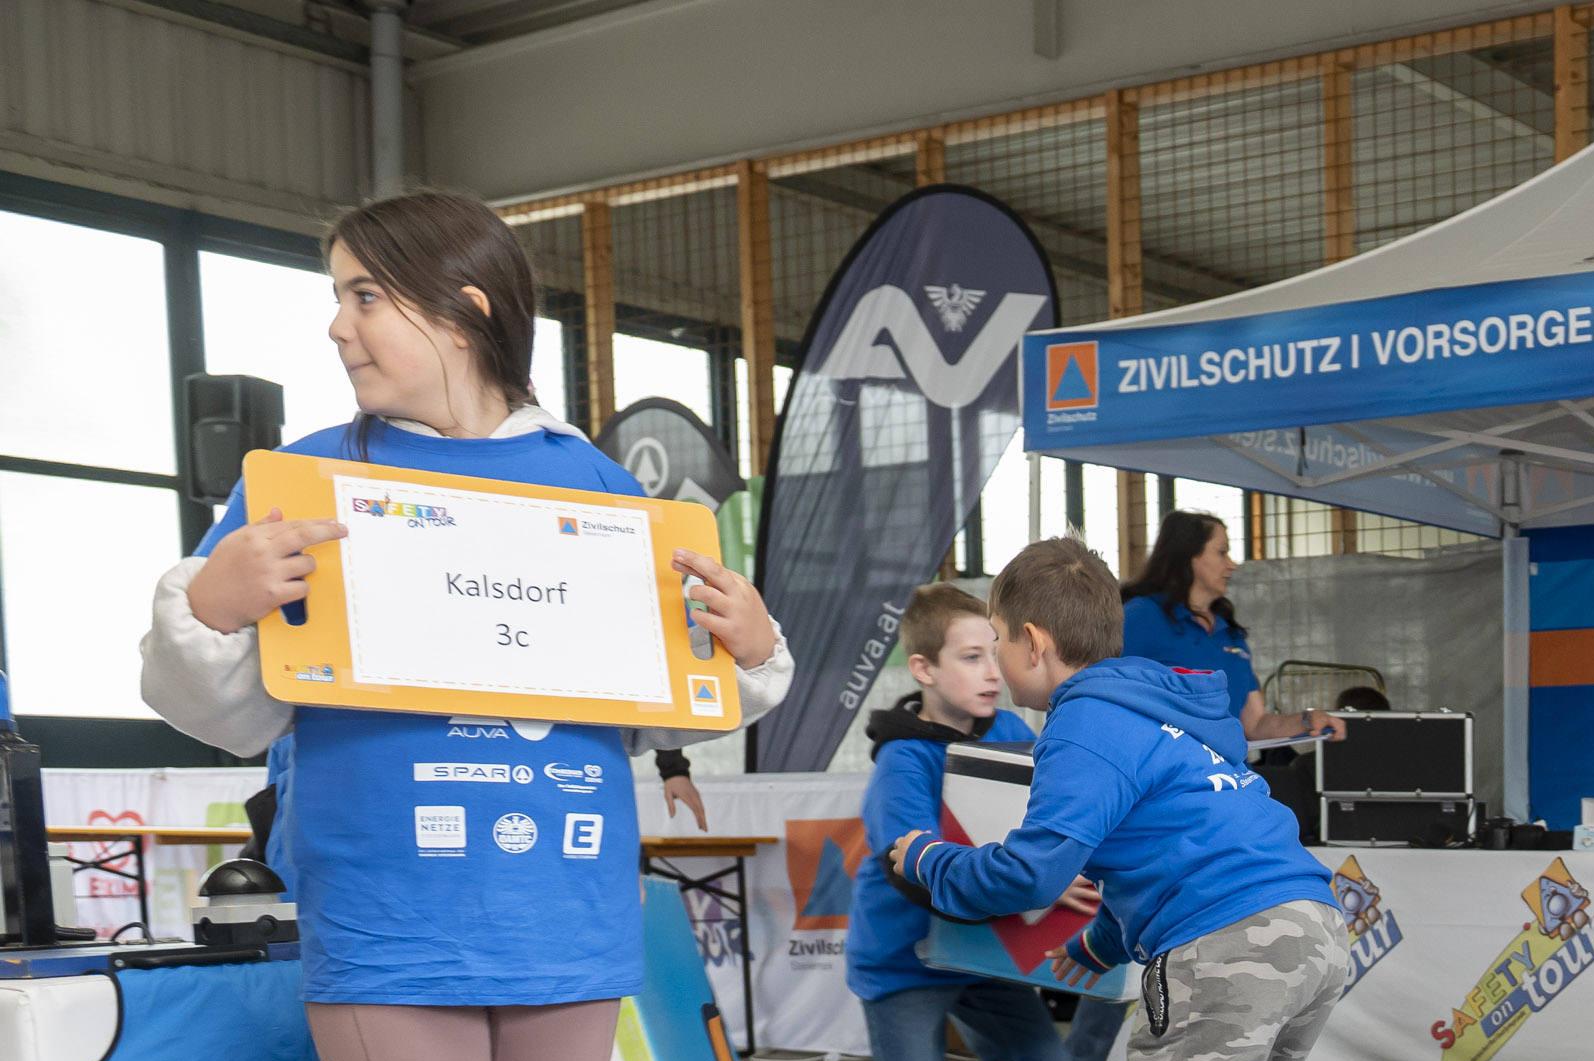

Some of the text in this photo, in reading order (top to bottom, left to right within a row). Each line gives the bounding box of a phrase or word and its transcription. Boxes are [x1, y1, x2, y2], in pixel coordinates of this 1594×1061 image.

[1117, 336, 1342, 393] ZIVILSCHUTZ
[582, 520, 636, 535] Zivilschutz
[446, 572, 567, 604] Kalsdorf
[496, 623, 531, 648] 3c
[839, 600, 906, 710] auva.at
[447, 726, 510, 739] AUVA
[434, 766, 508, 780] SPAR
[421, 824, 461, 832] NETZE
[1431, 940, 1536, 1050] SAFETY
[1490, 1000, 1515, 1026] on
